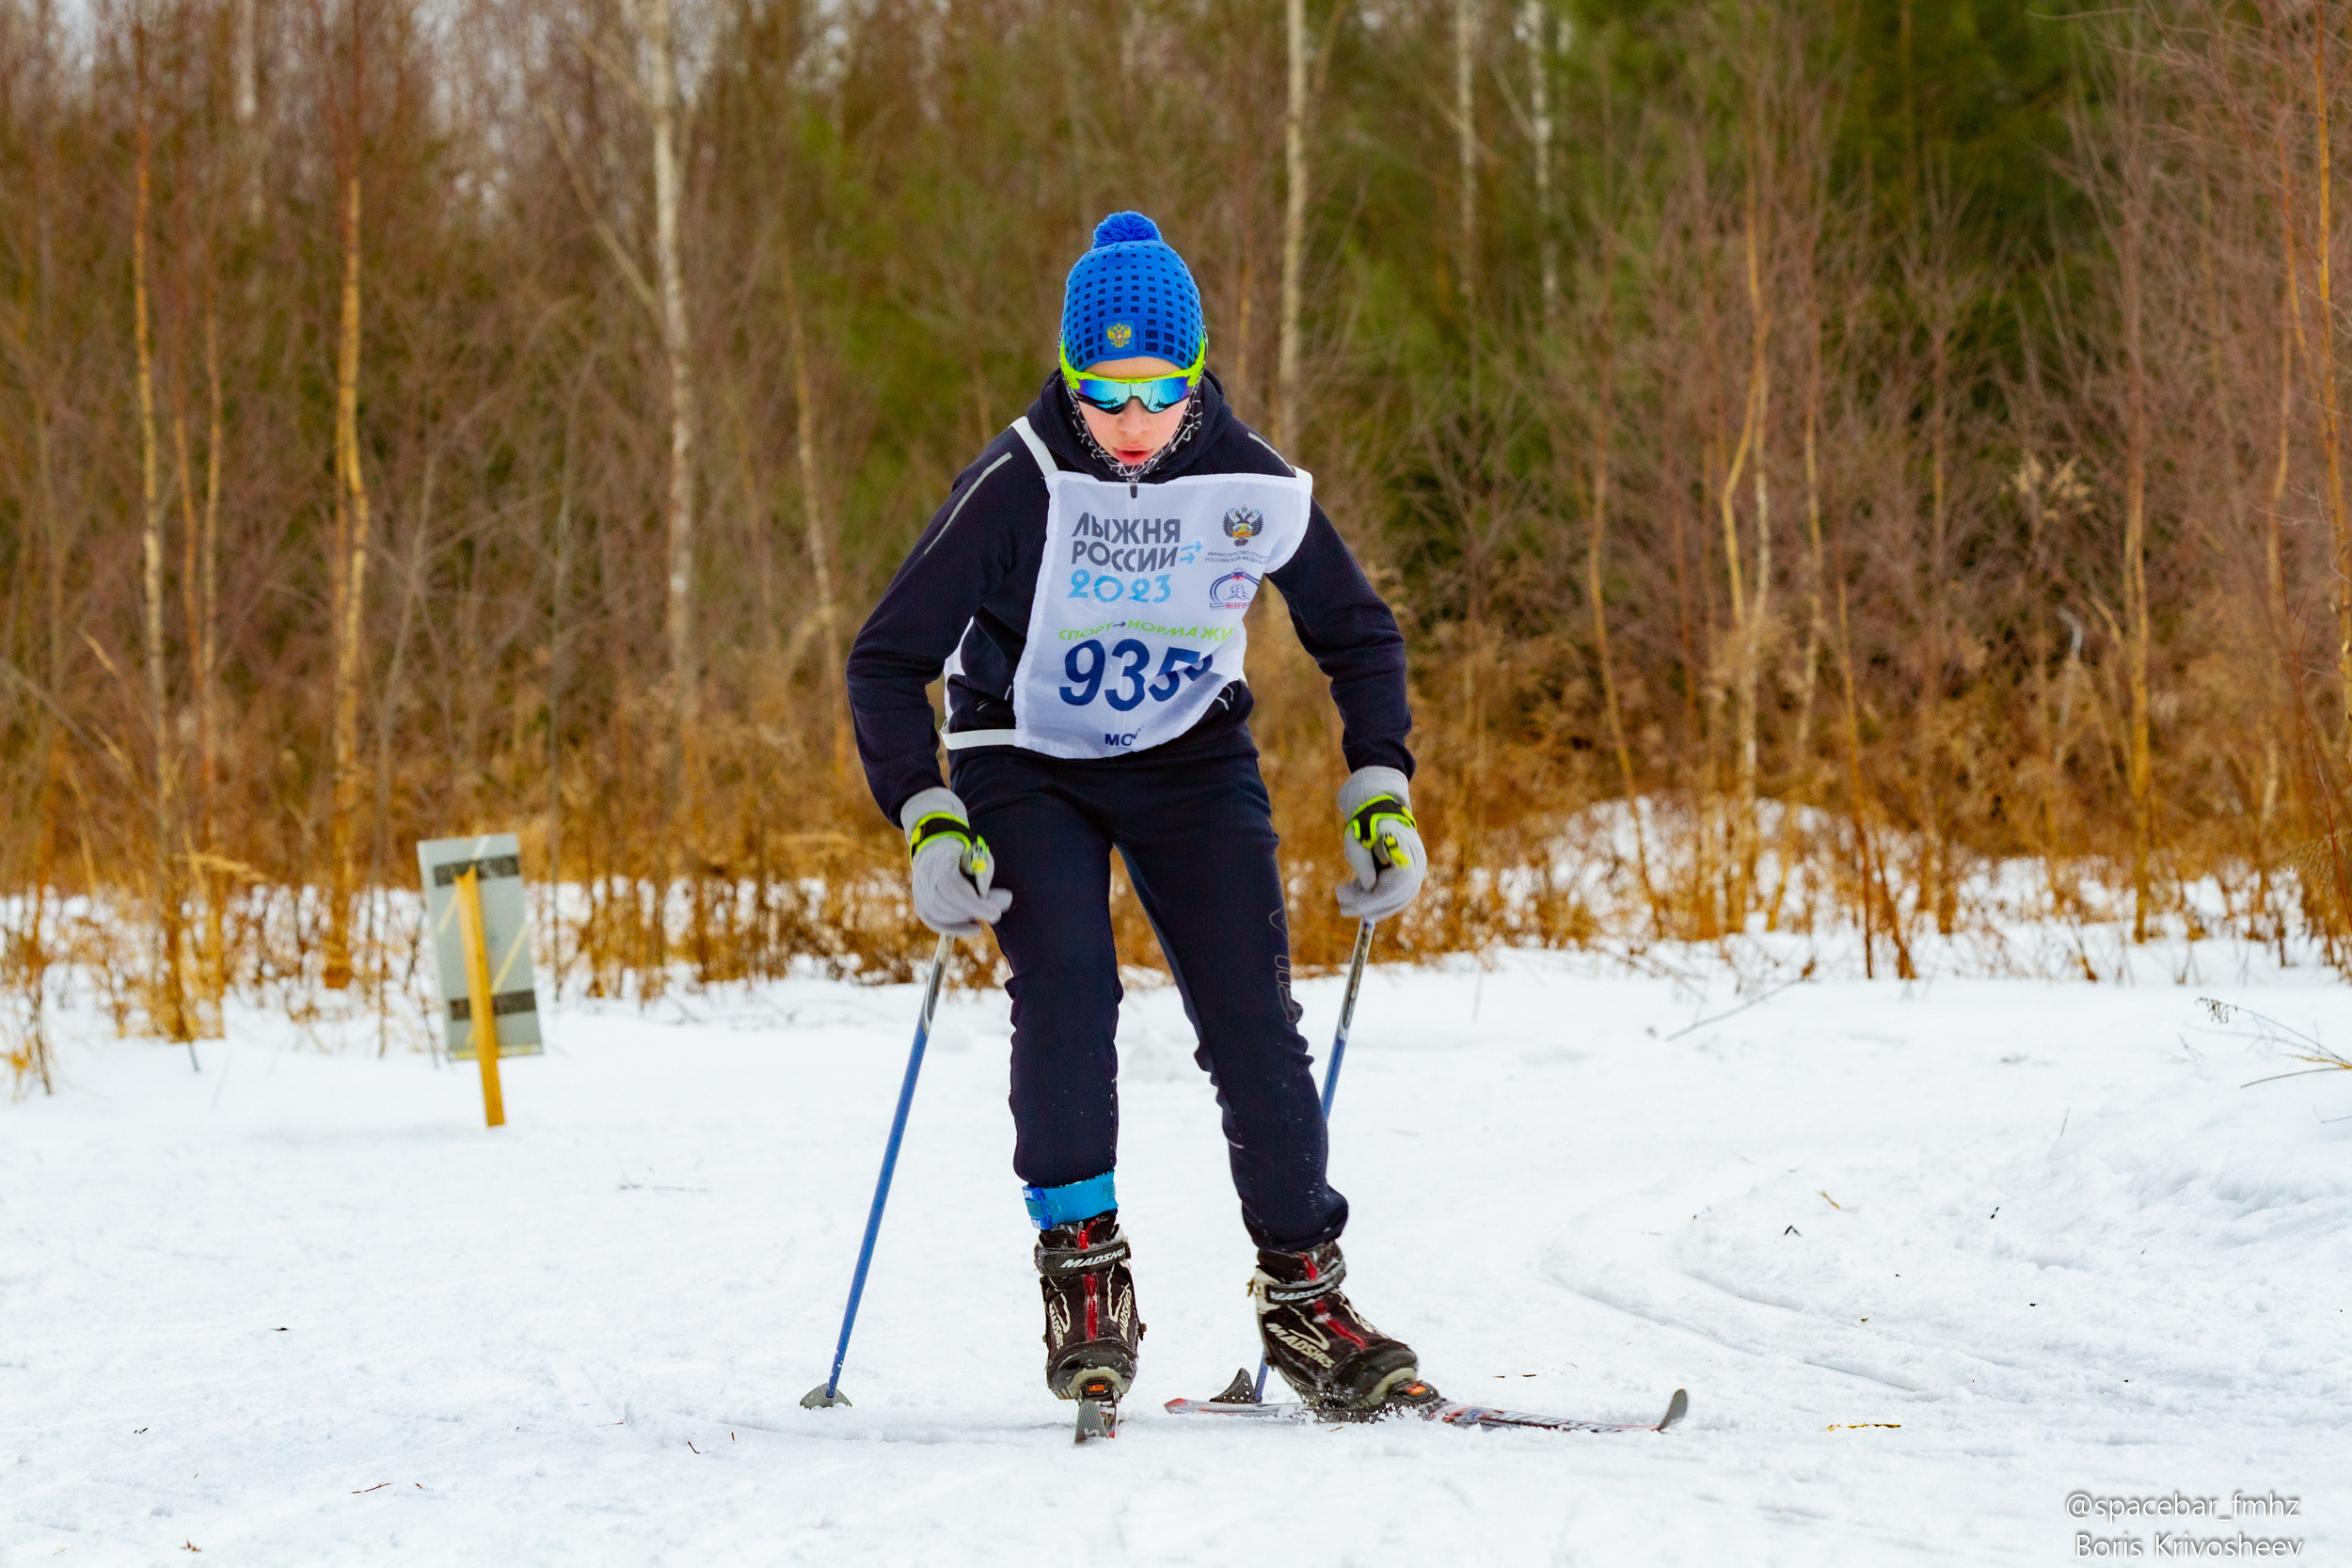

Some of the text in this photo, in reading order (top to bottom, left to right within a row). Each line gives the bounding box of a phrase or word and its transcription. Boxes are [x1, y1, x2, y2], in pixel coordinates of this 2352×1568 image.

[1071, 512, 1181, 544] ЛЫЖНЯ
[1071, 540, 1179, 572] РОССИИ
[1067, 568, 1171, 603] 2023
[1058, 622, 1114, 641] СПОРТ
[1127, 619, 1198, 638] НОРМА
[1060, 1247, 1126, 1269] MADSHU
